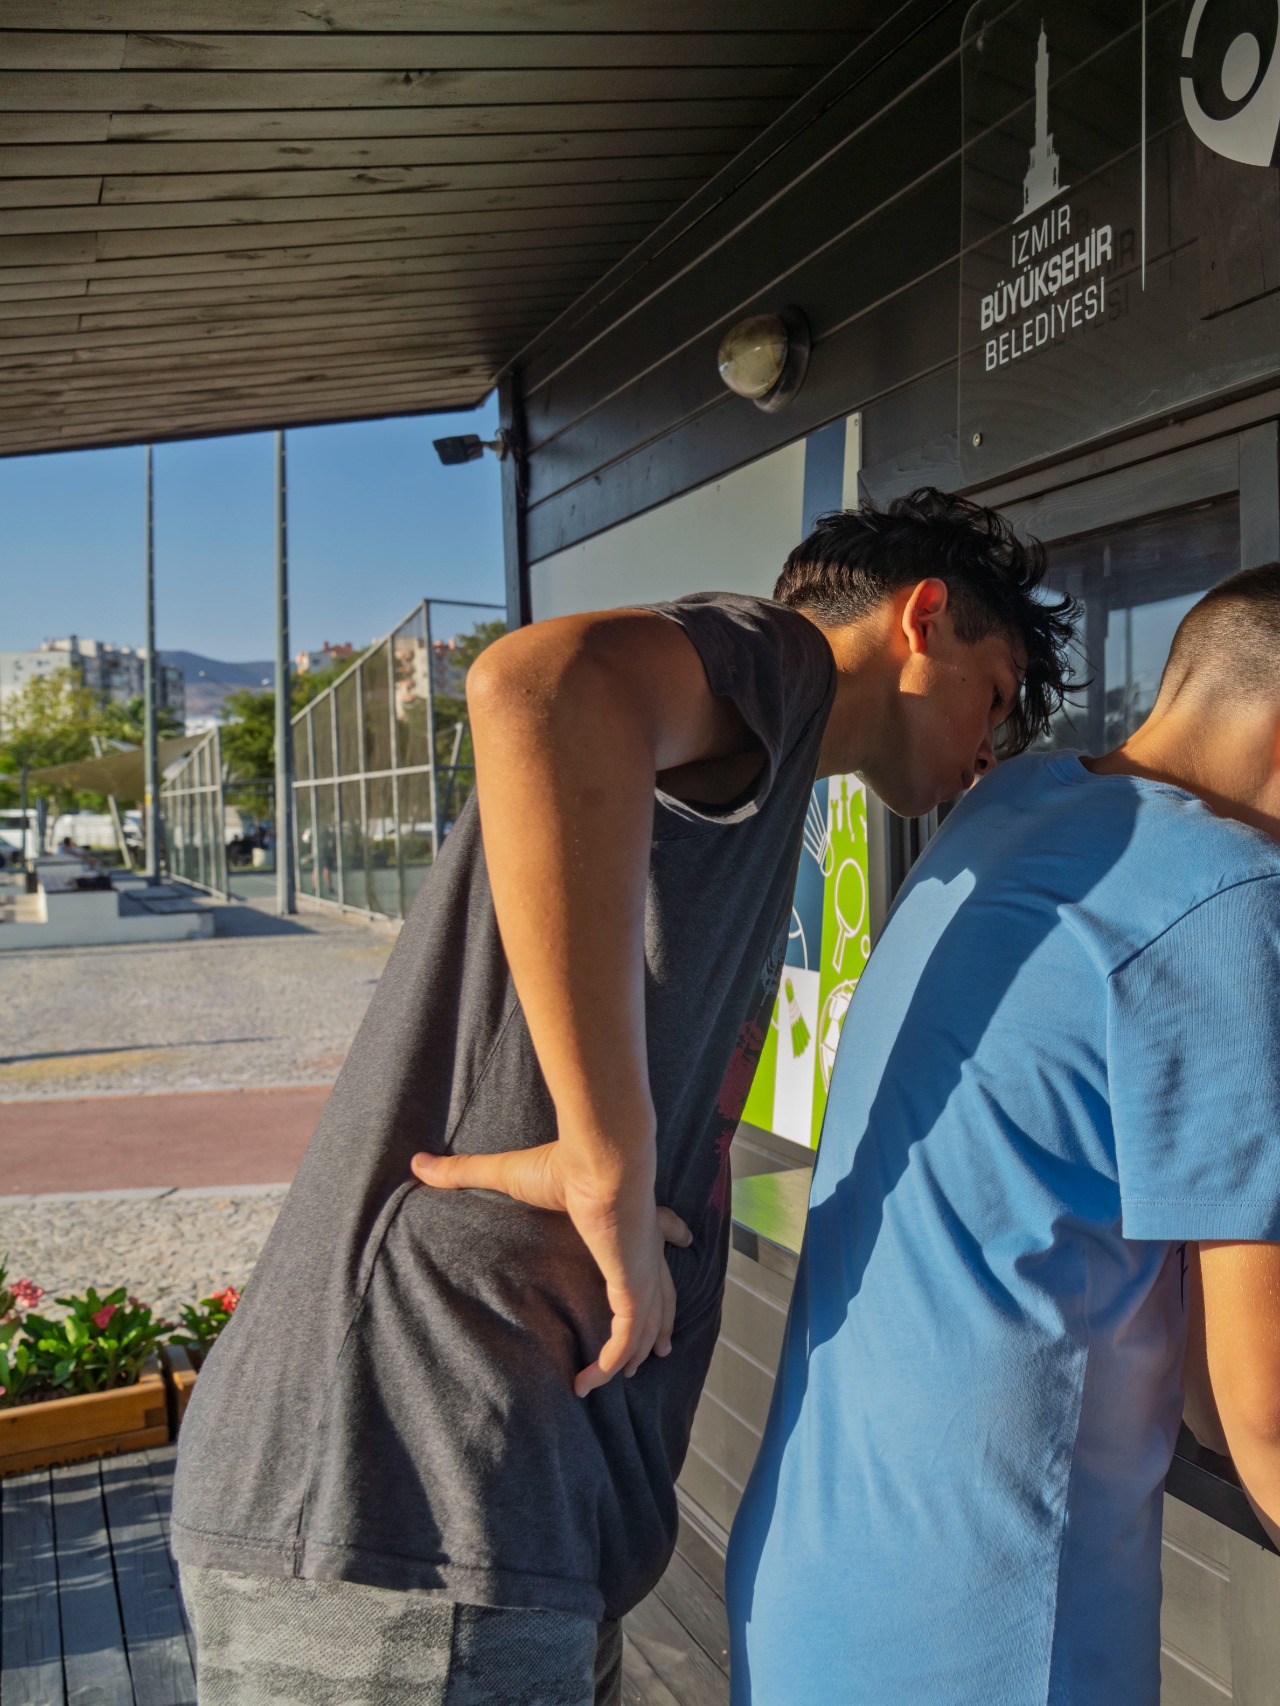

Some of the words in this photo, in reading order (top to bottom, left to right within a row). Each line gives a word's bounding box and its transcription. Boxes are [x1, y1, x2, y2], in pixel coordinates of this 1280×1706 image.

[980, 224, 1112, 331] BÜYÜKŞEHİR
[1012, 204, 1071, 269] İZMİR
[985, 276, 1105, 372] BELEDİYESİ
